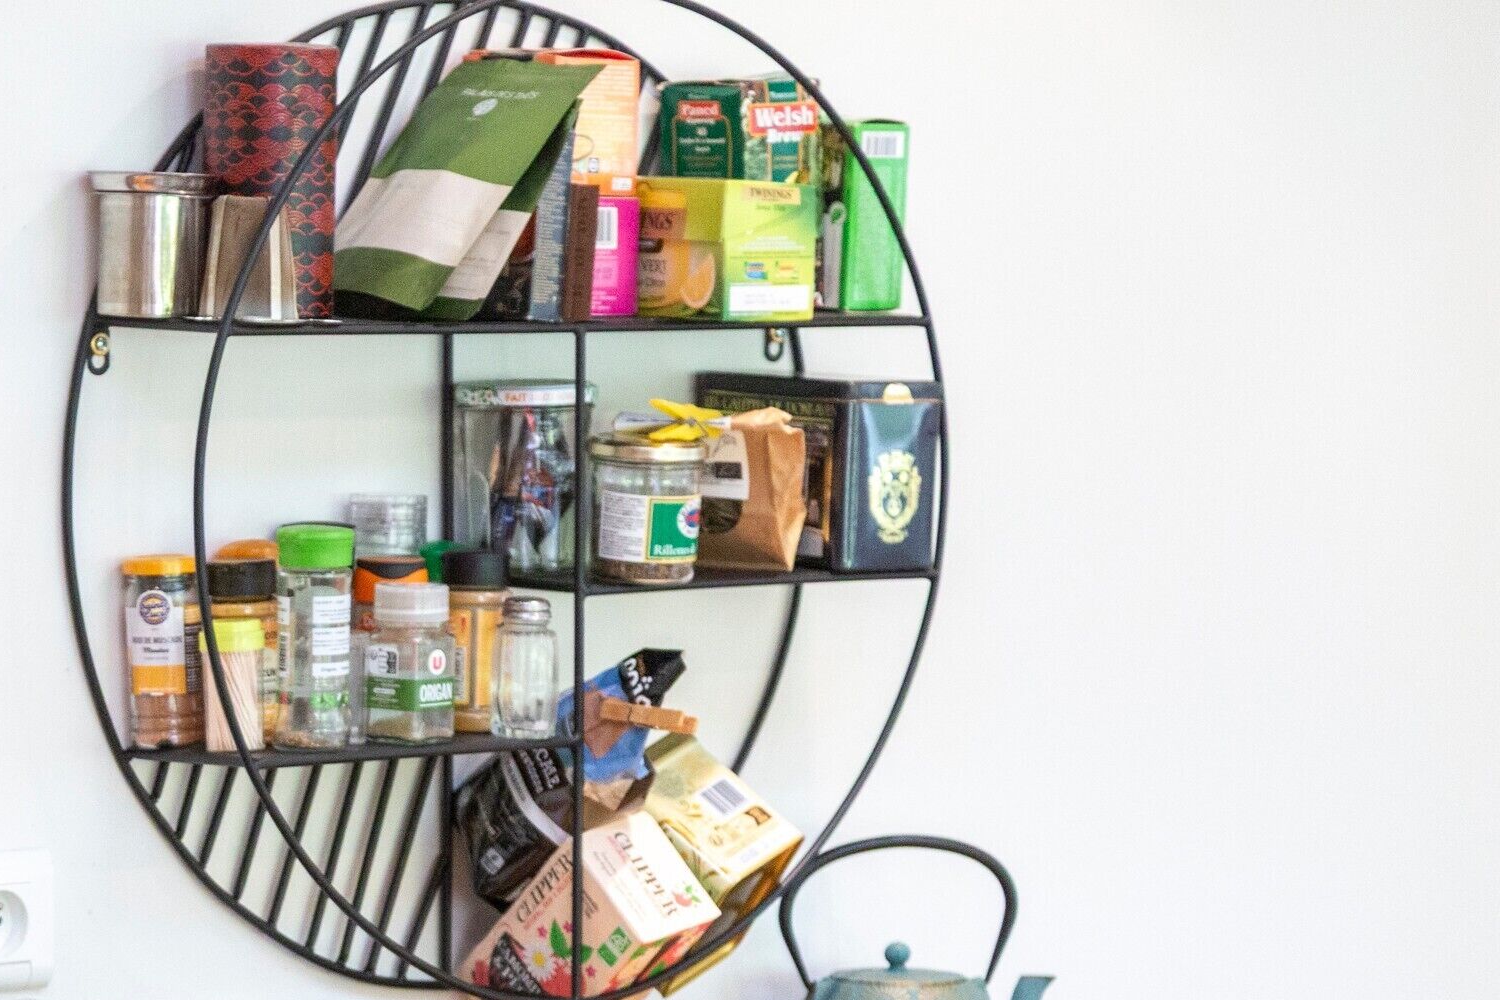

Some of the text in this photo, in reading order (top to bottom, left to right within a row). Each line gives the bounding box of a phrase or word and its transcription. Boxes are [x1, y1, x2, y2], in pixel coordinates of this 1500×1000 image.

[755, 105, 815, 128] Welsh
[433, 655, 443, 670] U
[419, 681, 454, 703] ORIGAN
[516, 854, 574, 923] CLIPPER
